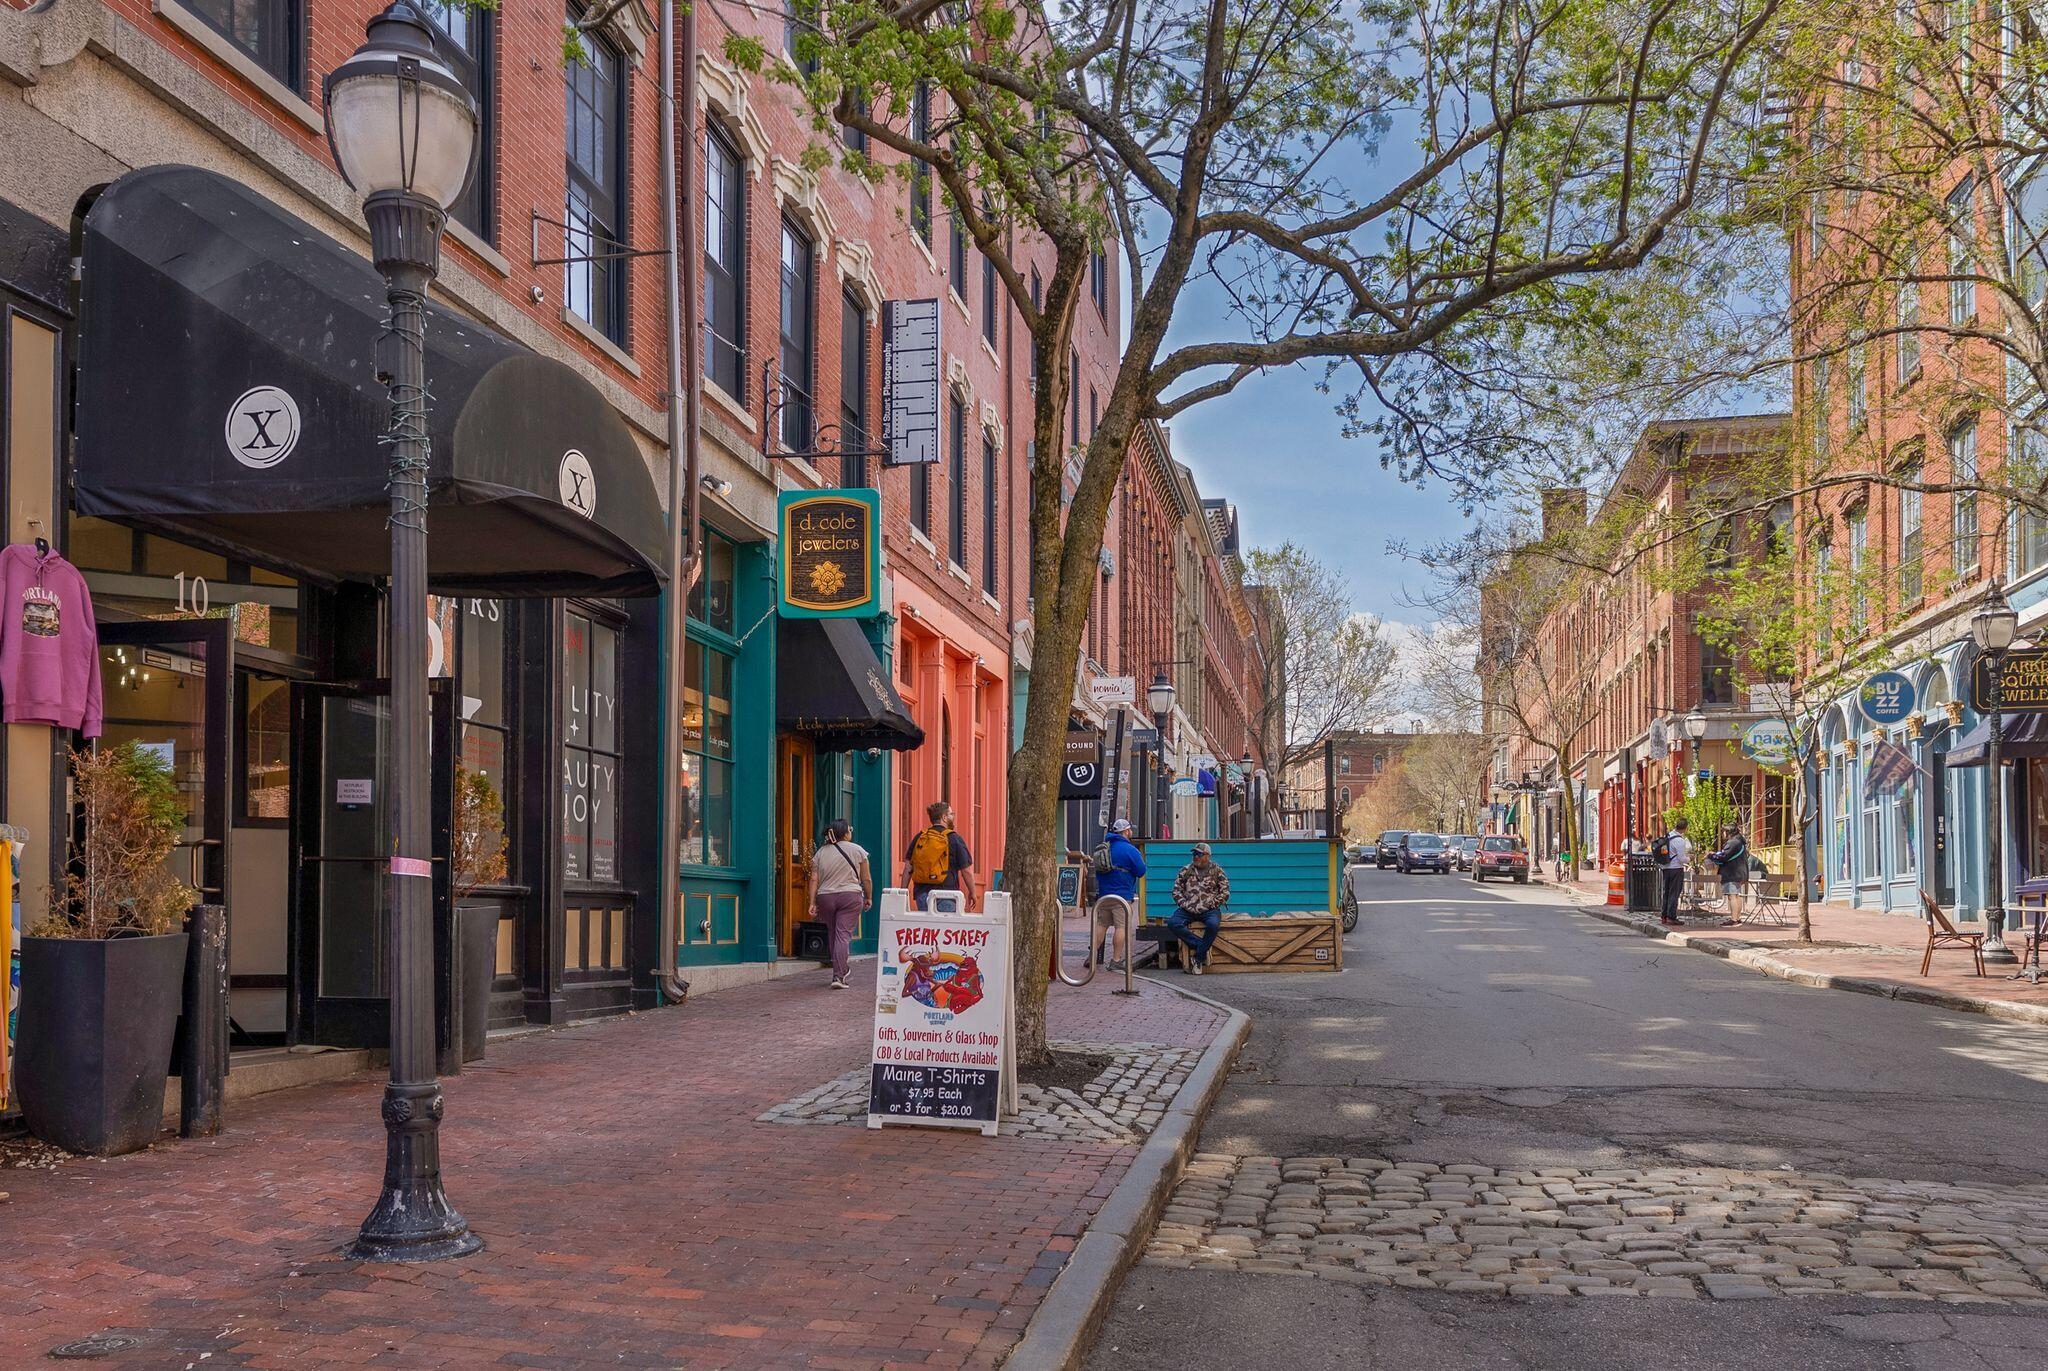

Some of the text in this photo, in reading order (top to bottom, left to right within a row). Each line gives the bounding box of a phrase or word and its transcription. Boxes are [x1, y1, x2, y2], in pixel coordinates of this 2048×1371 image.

[883, 343, 893, 439] Paul Stuart Photography
[243, 409, 282, 450] X
[567, 468, 587, 510] X
[820, 513, 856, 529] cole
[797, 536, 860, 555] jewelers
[174, 571, 208, 617] 10
[2004, 661, 2048, 672] ARKE
[1093, 683, 1121, 693] nomia
[1876, 682, 1899, 695] BU
[1876, 696, 1900, 707] ZZ
[1073, 765, 1088, 778] EB
[896, 928, 990, 947] FREAK STREET
[923, 1011, 954, 1021] PORTLAND
[878, 1027, 999, 1049] Gifts, Souvenirs & Glass Shop
[877, 1046, 998, 1066] CBD & Local Products Available
[928, 1068, 986, 1086] T-Shirts
[908, 1087, 962, 1100] $7.95 Each
[889, 1103, 972, 1117] or 3 for $20.00
